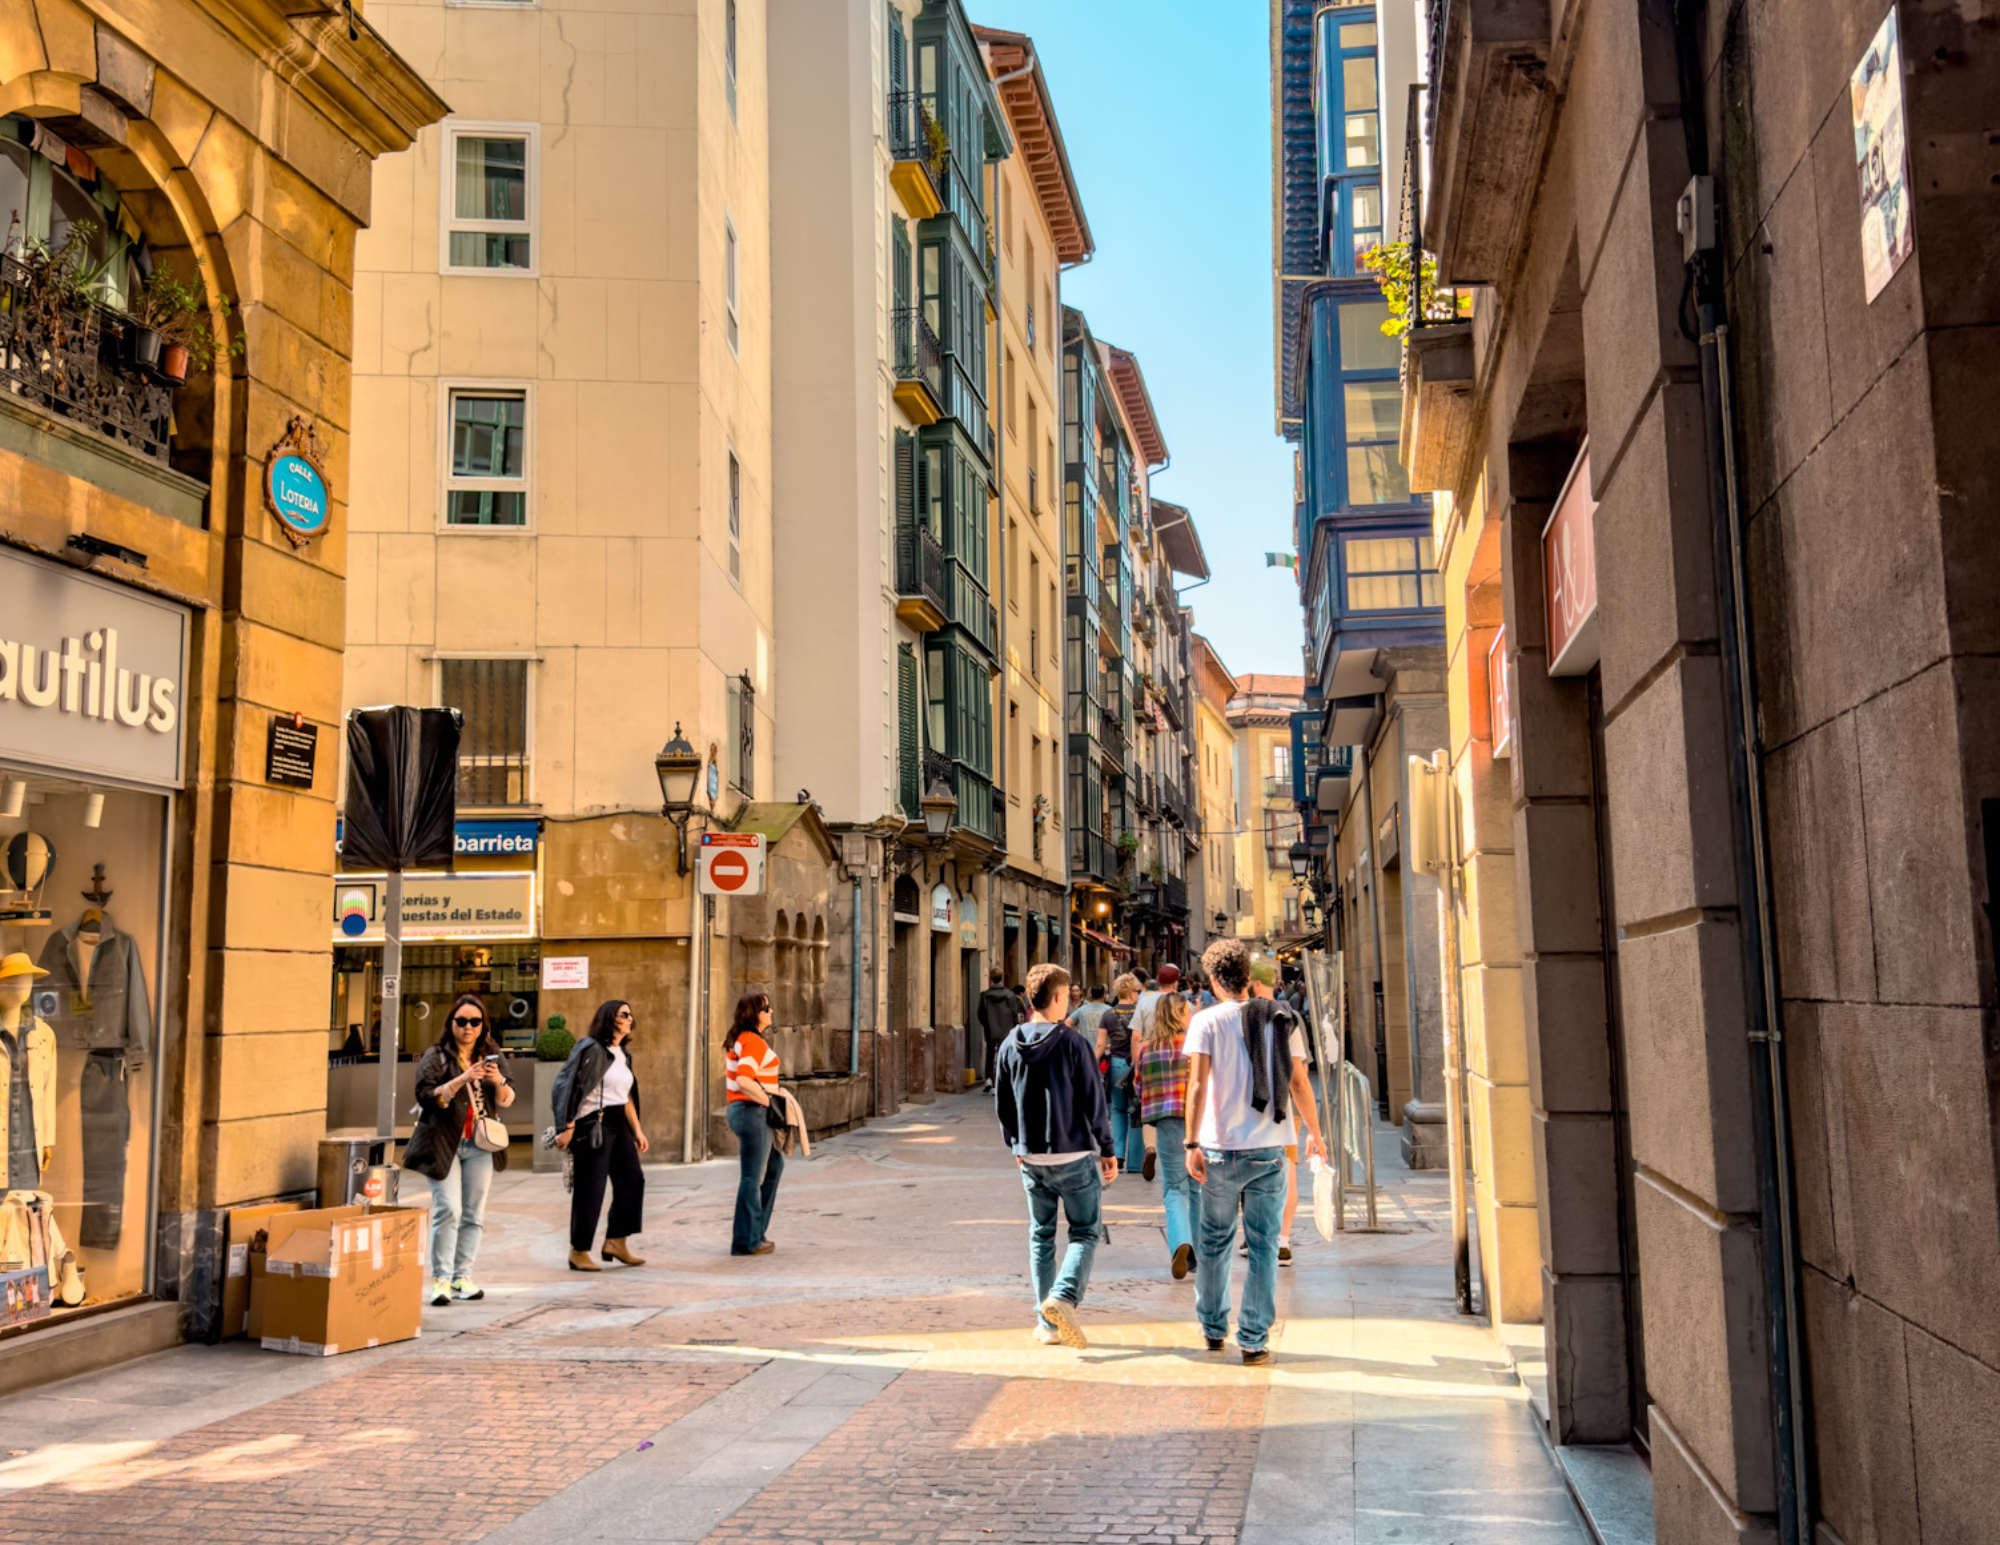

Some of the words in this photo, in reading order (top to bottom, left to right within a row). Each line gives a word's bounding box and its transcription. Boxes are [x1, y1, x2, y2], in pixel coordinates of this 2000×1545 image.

[289, 462, 313, 483] CALLE
[280, 480, 319, 514] LOTERIA
[382, 893, 439, 907] erías
[442, 896, 451, 909] y
[382, 909, 447, 922] uestas
[450, 909, 472, 922] del
[475, 908, 522, 921] Estado
